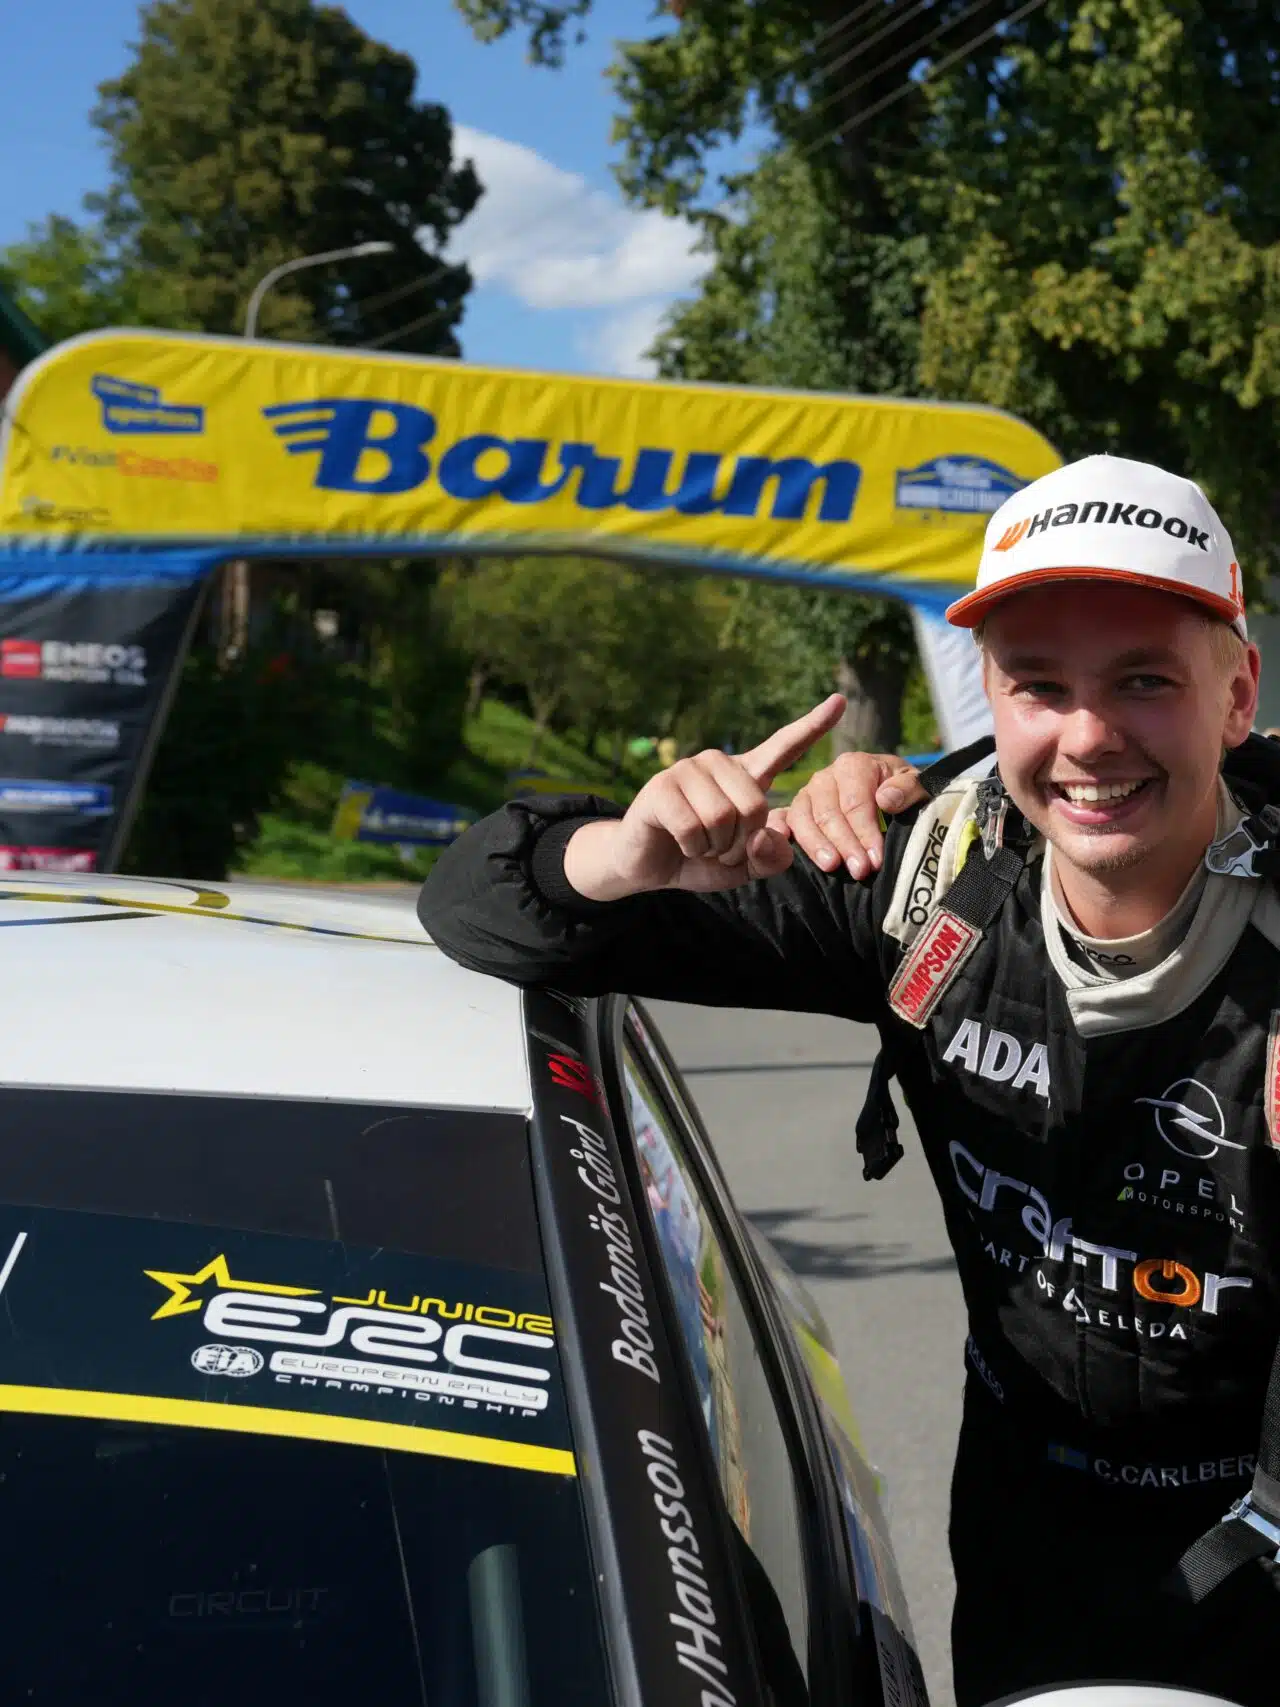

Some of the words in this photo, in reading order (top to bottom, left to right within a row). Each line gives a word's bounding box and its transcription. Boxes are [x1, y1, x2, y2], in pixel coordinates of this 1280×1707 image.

[262, 398, 863, 522] Barum
[901, 923, 963, 1013] SIMPSON
[559, 1114, 622, 1205] Gård
[1123, 1162, 1245, 1216] OPEL
[1123, 1185, 1245, 1234] MOTORSPORT
[332, 1288, 554, 1336] JUNIOR
[588, 1202, 661, 1385] Bodanäs
[1036, 1268, 1056, 1298] OF
[1099, 1308, 1188, 1341] ELEDA
[204, 1291, 555, 1382] ERC
[275, 1373, 538, 1418] CHAMPIONSHIP
[280, 1356, 441, 1387] EUROPEAN
[448, 1379, 540, 1402] RALLY
